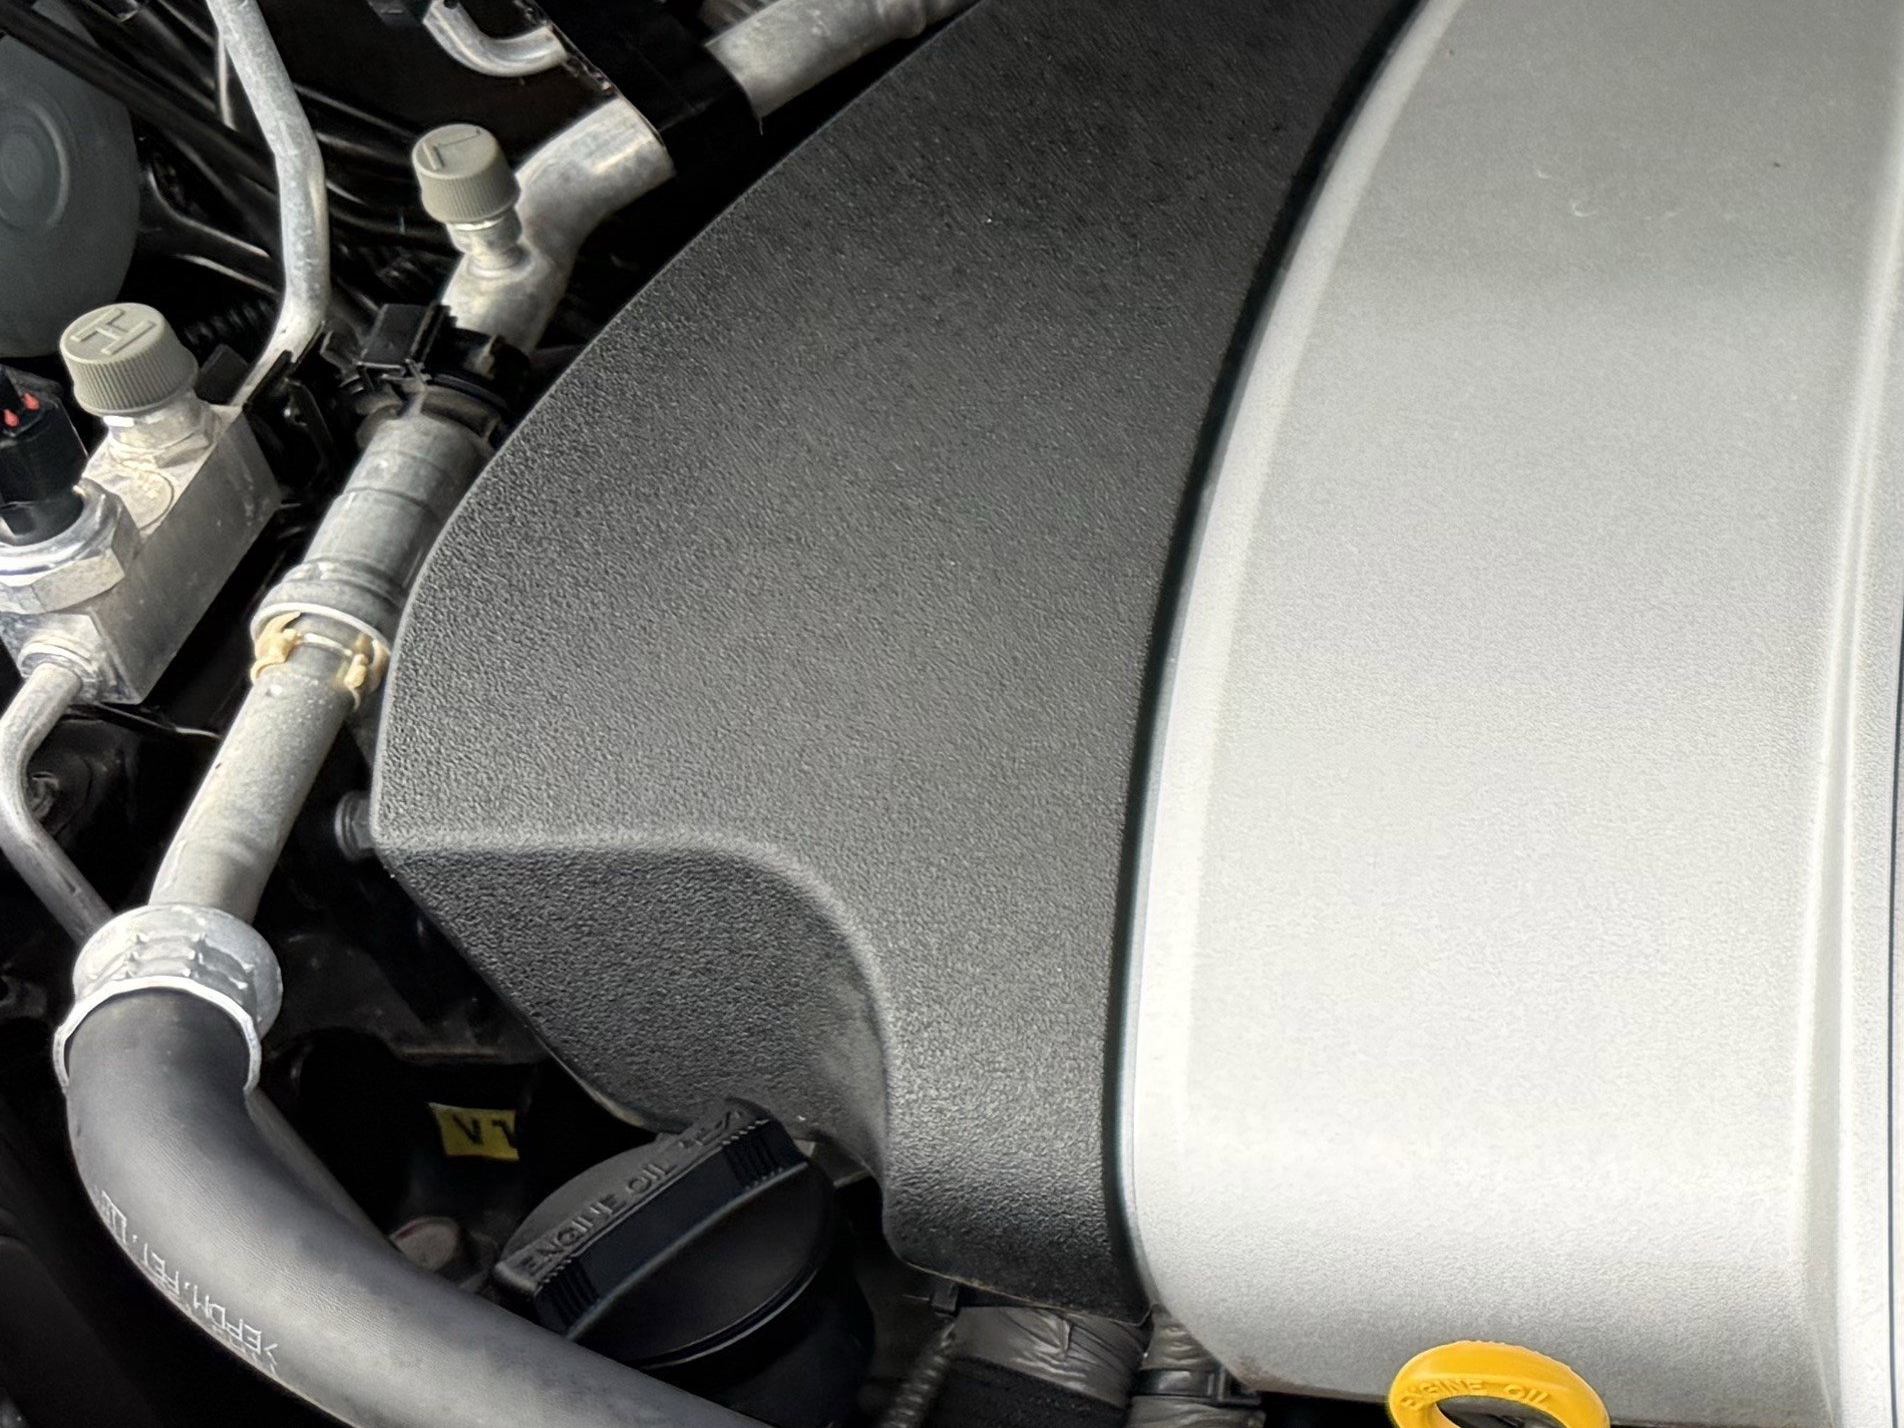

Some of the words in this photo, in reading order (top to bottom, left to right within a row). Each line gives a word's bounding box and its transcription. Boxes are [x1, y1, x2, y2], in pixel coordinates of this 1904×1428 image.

[70, 306, 157, 356] H
[521, 1194, 628, 1274] ENGINE
[625, 1161, 677, 1196] OIL
[1502, 1383, 1551, 1405] OIL
